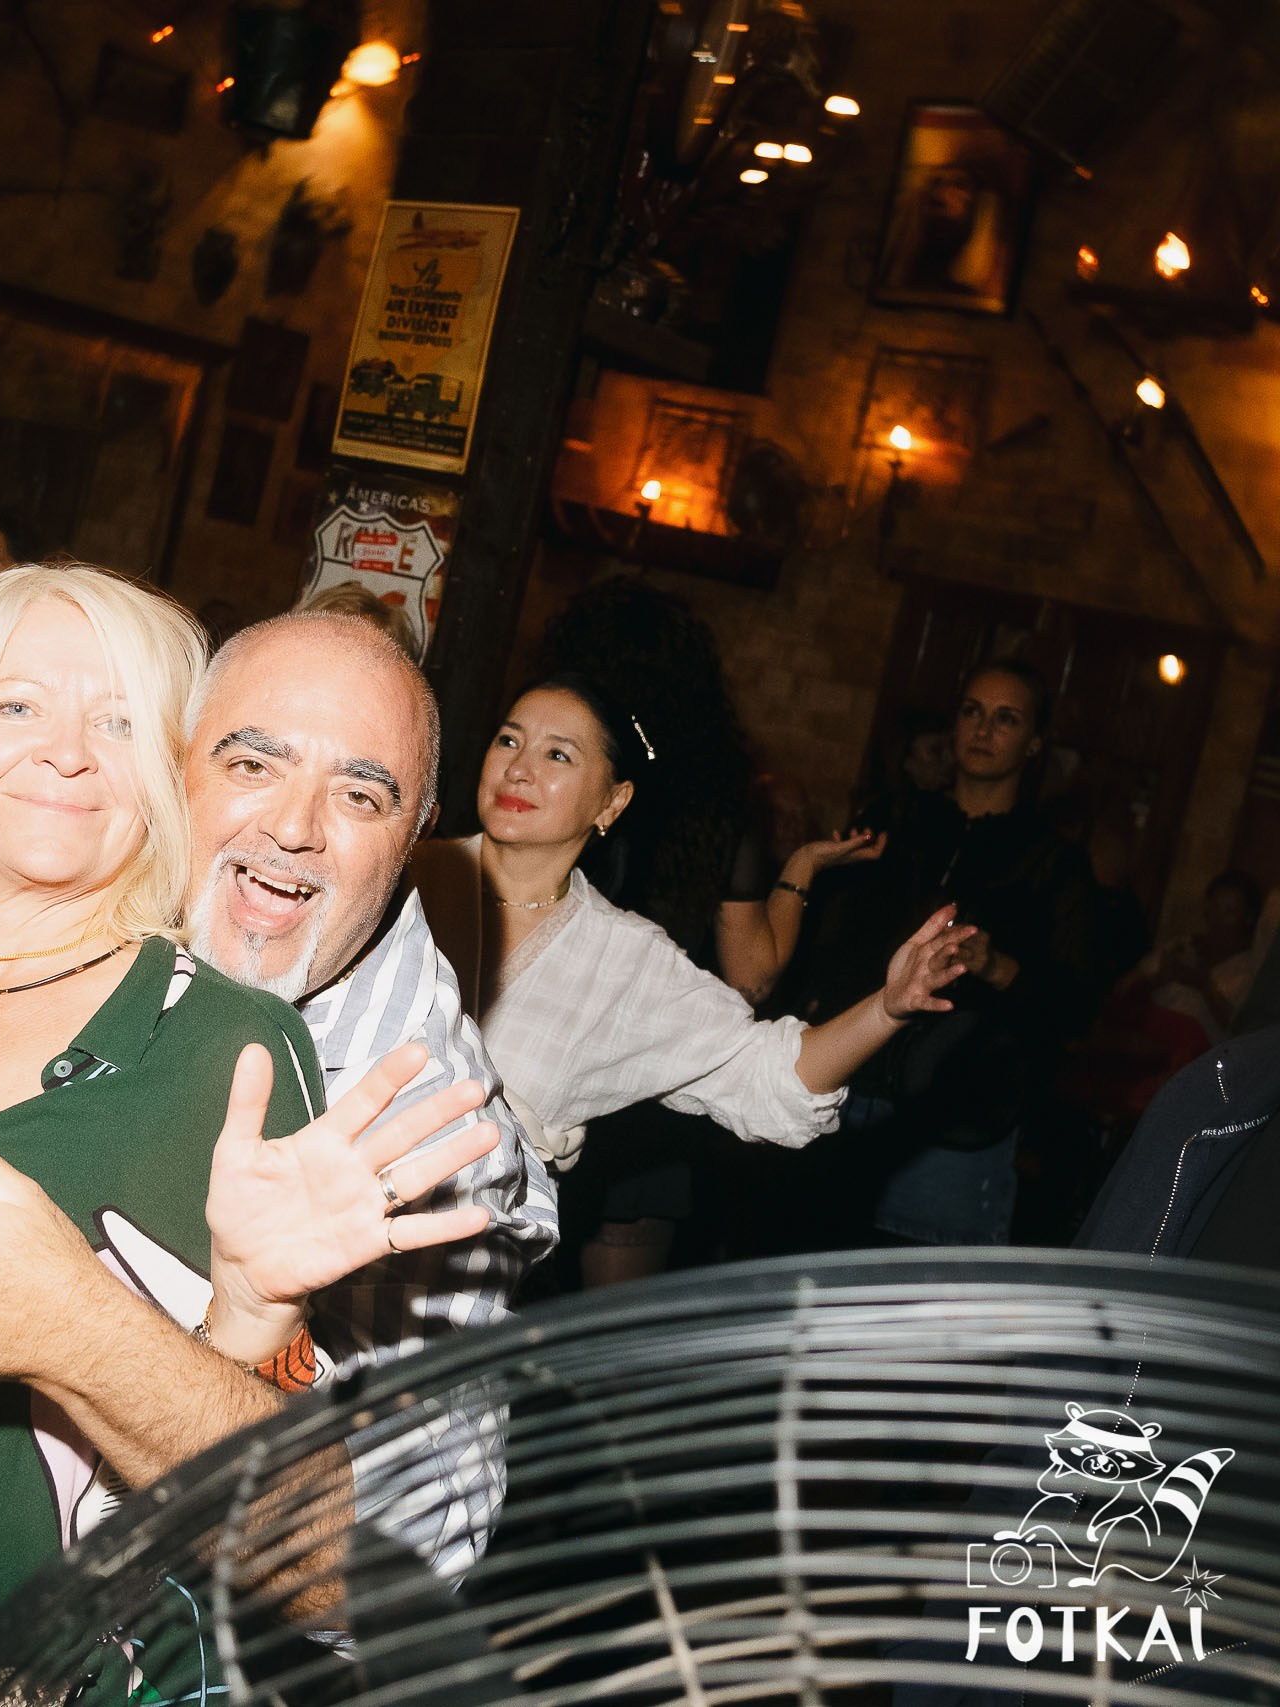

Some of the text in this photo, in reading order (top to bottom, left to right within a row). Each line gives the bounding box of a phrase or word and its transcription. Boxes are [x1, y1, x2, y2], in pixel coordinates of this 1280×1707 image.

[384, 299, 458, 319] AIR EXPRESS
[386, 315, 450, 334] DIVISION
[1201, 1123, 1243, 1136] PREMIUM
